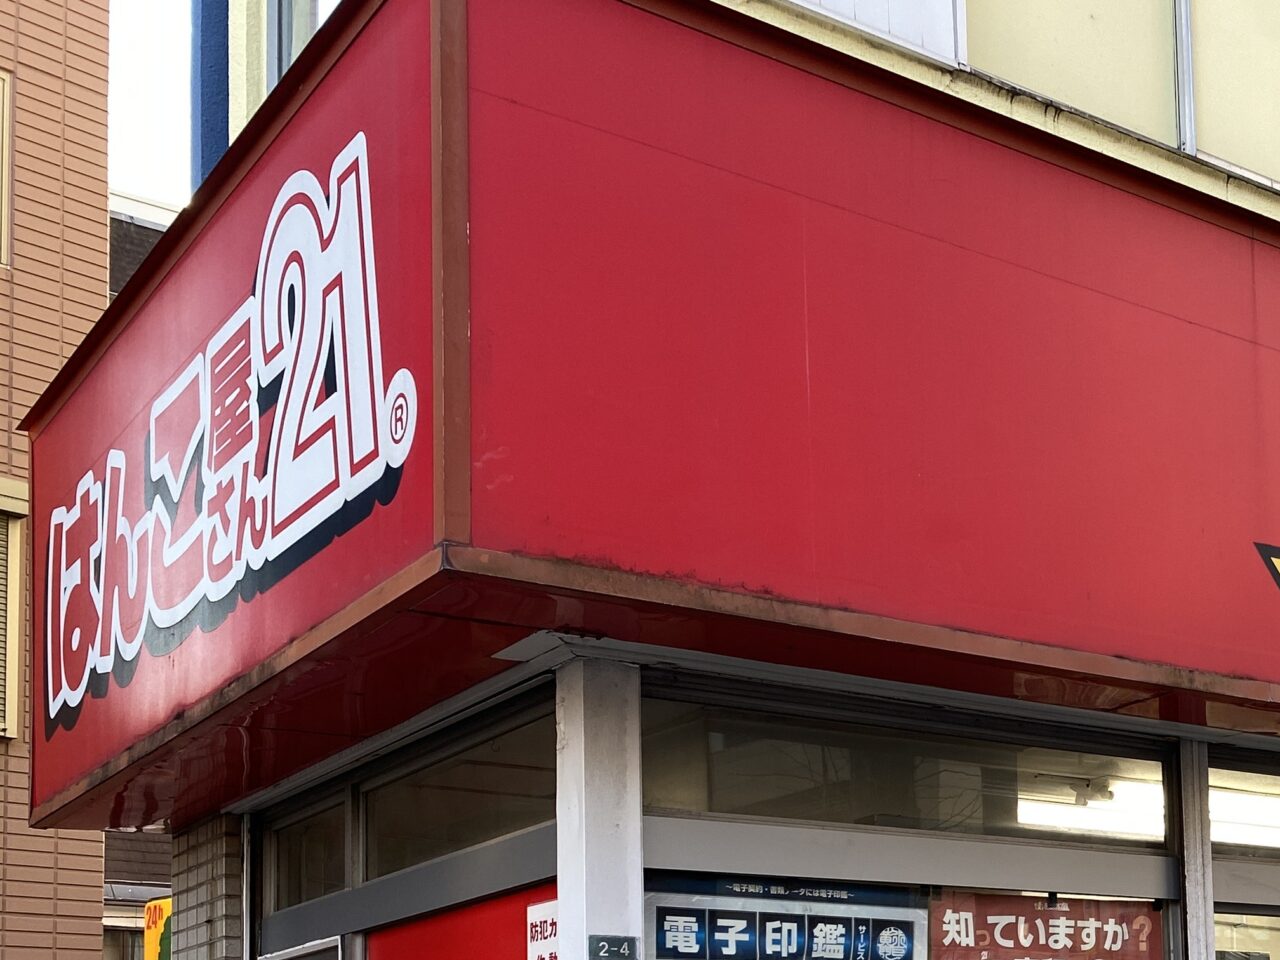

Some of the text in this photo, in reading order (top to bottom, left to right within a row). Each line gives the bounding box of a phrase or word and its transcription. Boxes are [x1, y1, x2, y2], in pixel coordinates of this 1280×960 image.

[147, 905, 163, 930] 24h
[943, 909, 1152, 952] 知っていますか？
[599, 942, 630, 956] 2-4
[663, 915, 865, 960] 電子印鑑 サービス
